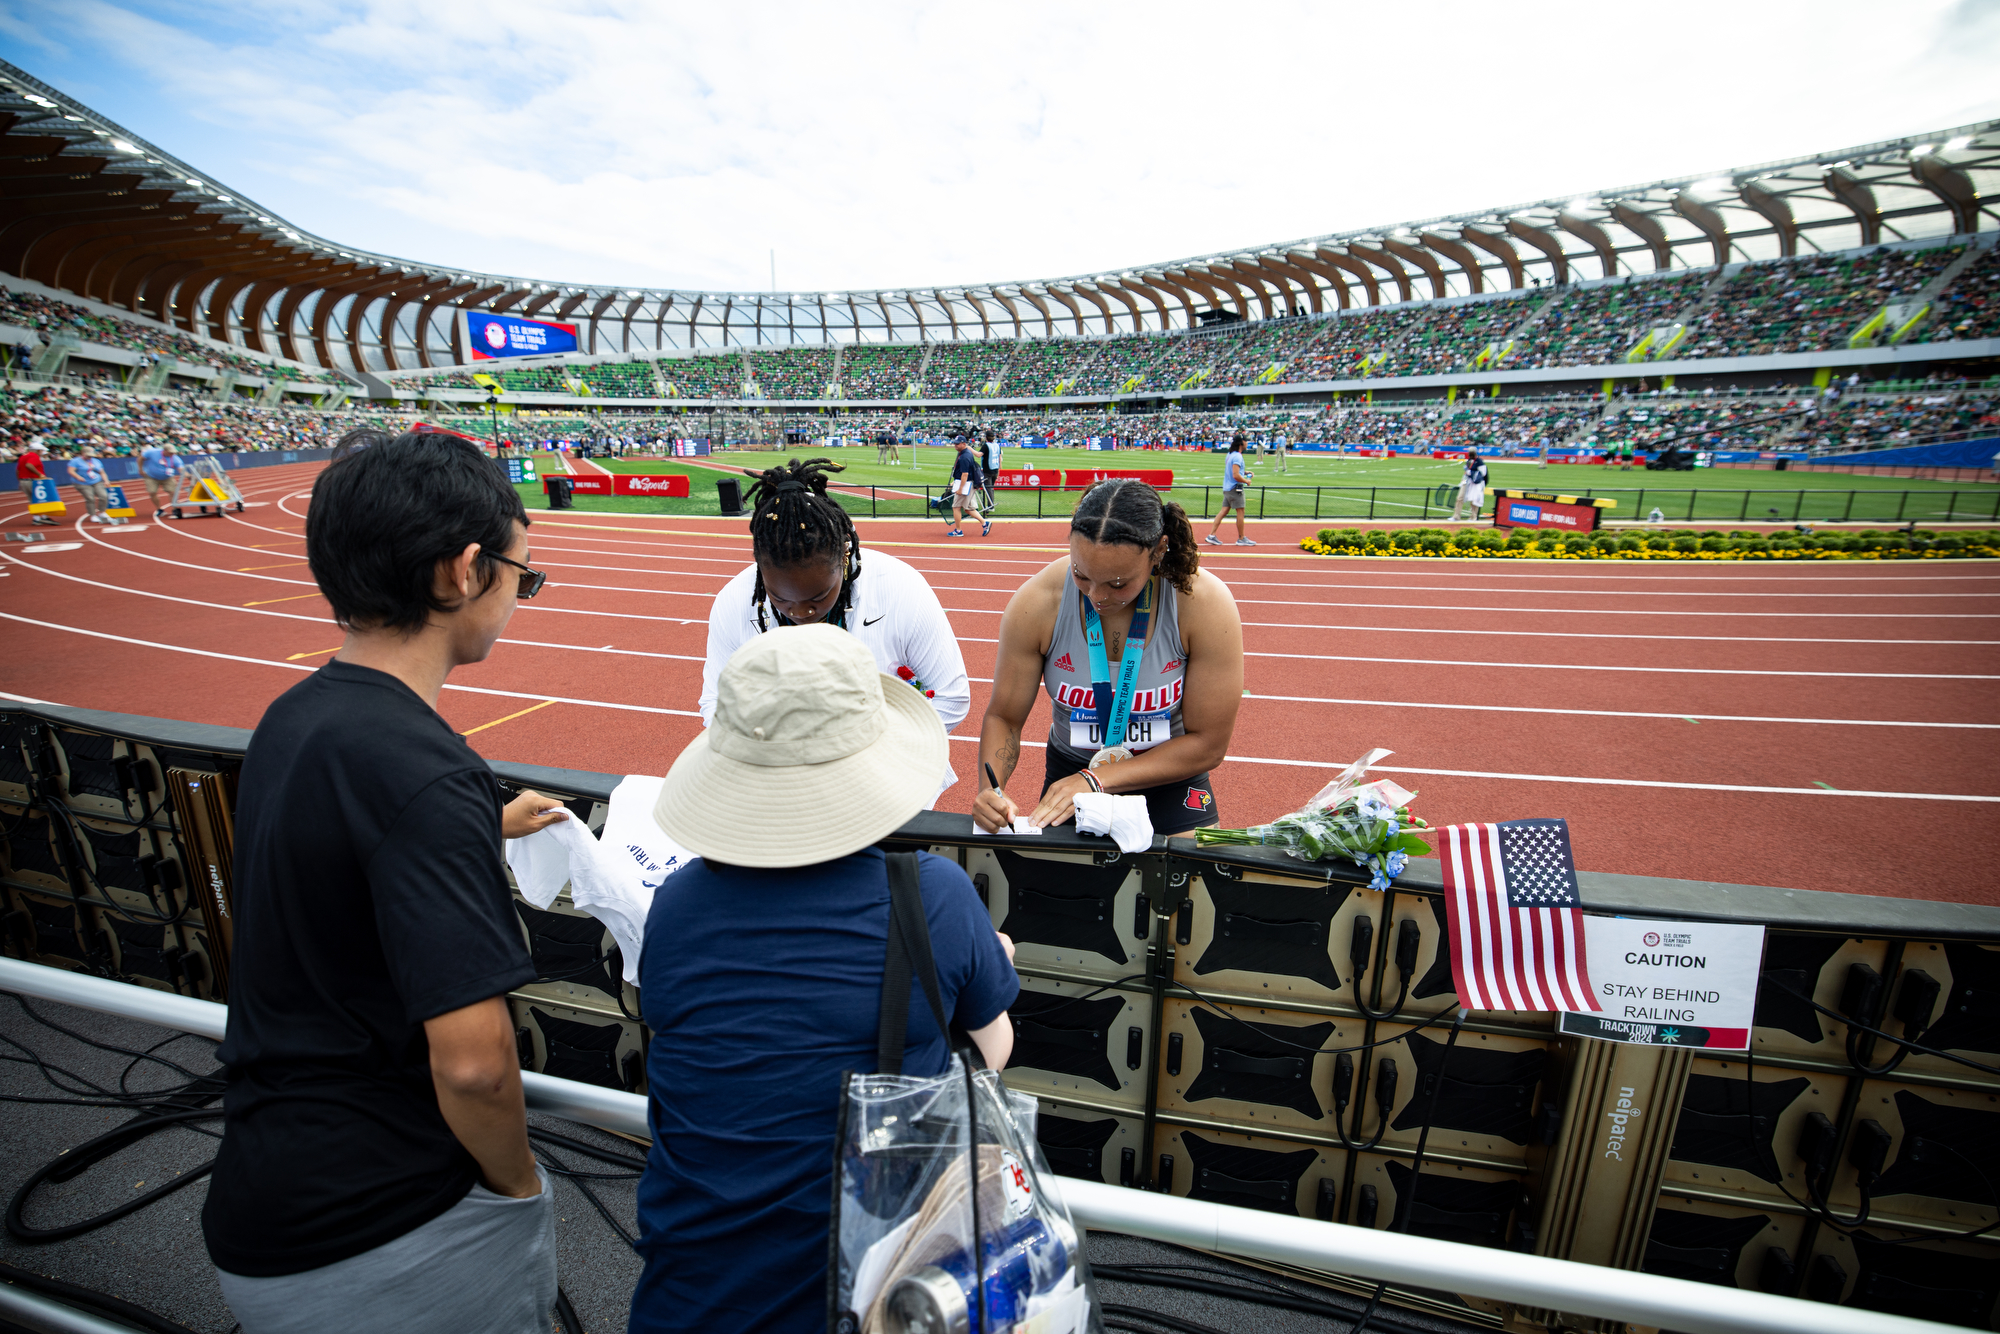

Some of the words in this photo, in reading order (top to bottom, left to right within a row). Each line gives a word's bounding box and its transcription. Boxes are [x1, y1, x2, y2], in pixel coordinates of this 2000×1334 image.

[521, 326, 546, 336] OLYMPIC
[510, 334, 526, 343] TEAM
[527, 335, 547, 345] TRIALS
[34, 485, 48, 500] 6
[640, 477, 670, 492] Sports
[108, 492, 120, 506] 5
[1526, 493, 1554, 501] OREGON
[1511, 507, 1526, 519] TEAM
[1526, 509, 1538, 520] USA
[1541, 513, 1553, 522] ONE
[1553, 514, 1565, 524] FOR
[1054, 661, 1075, 673] adidas
[1124, 660, 1135, 681] TRIALS
[1054, 676, 1183, 713] LOUILLE
[1121, 682, 1130, 699] TEAM
[1116, 699, 1127, 724] OLYMPIC
[1625, 952, 1706, 968] CAUTION
[1603, 983, 1648, 998] STAY
[1653, 988, 1720, 1003] BEHIND
[1624, 1005, 1695, 1022] RAILING
[1599, 1019, 1657, 1036] TRACKTOWN
[1628, 1033, 1653, 1043] 2024
